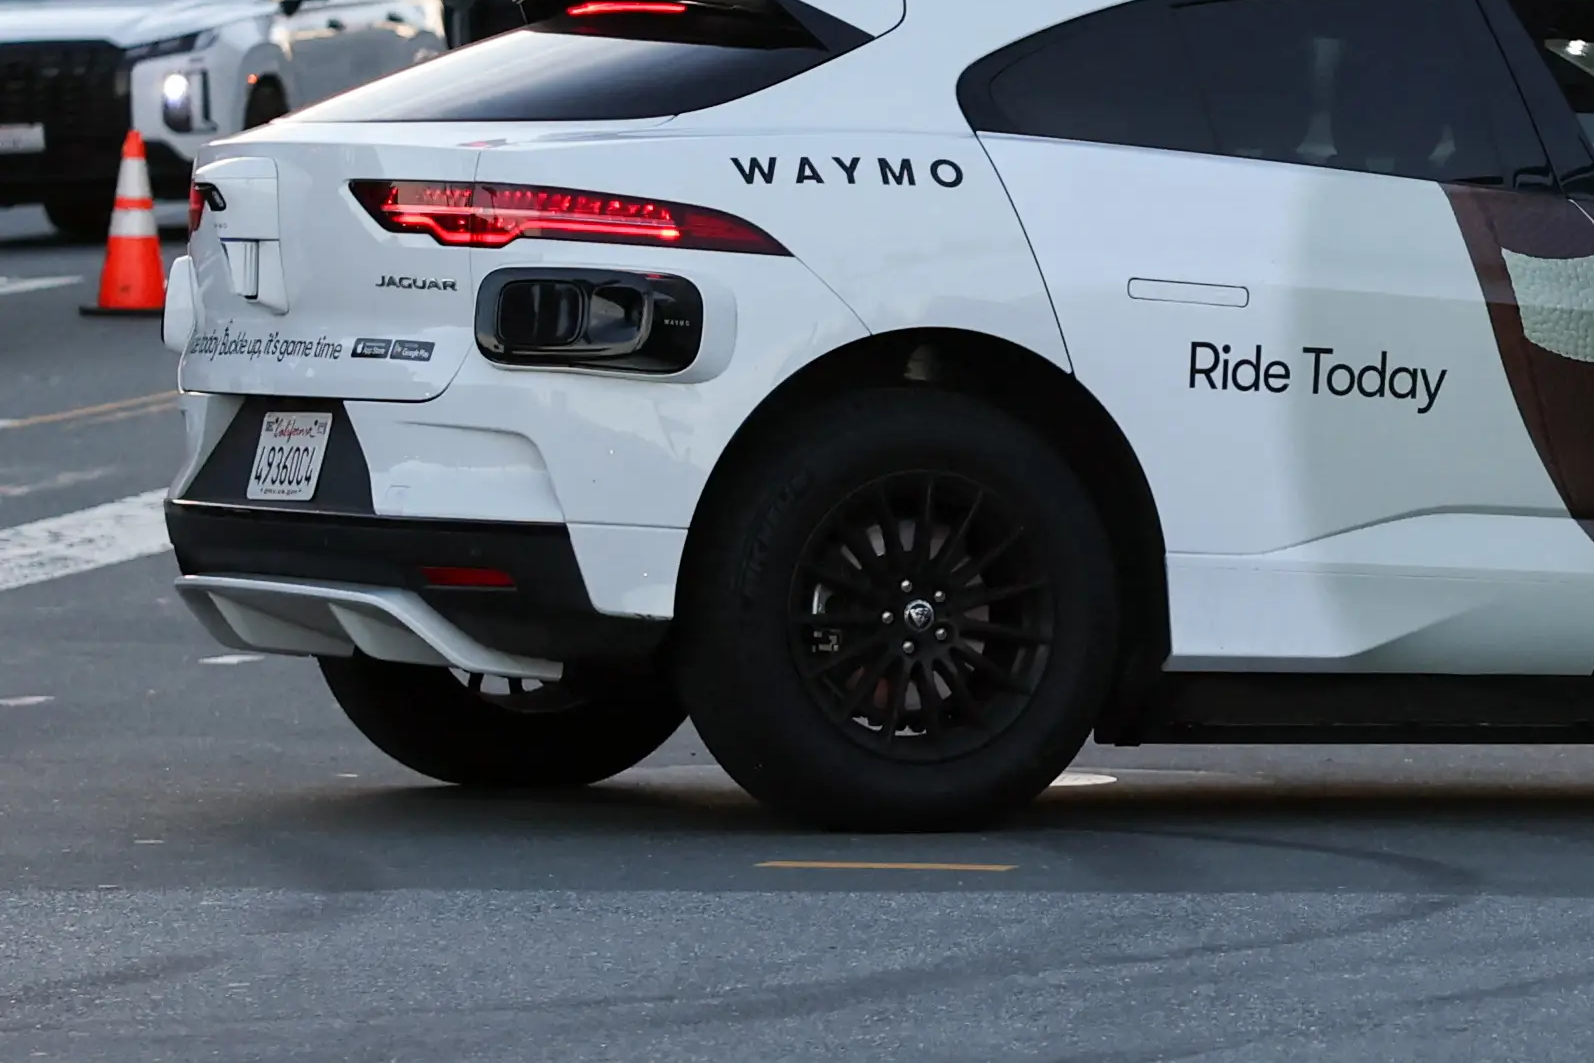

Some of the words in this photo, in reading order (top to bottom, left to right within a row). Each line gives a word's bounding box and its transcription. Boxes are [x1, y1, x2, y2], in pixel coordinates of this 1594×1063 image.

[729, 156, 964, 188] WAYMO
[375, 275, 458, 292] JAGUAR
[663, 319, 691, 327] WAYMO
[264, 331, 280, 355] it's
[277, 339, 313, 363] game
[315, 335, 343, 360] time
[1189, 341, 1291, 393] Ride
[1302, 346, 1448, 414] Today
[255, 445, 316, 487] 49360C4
